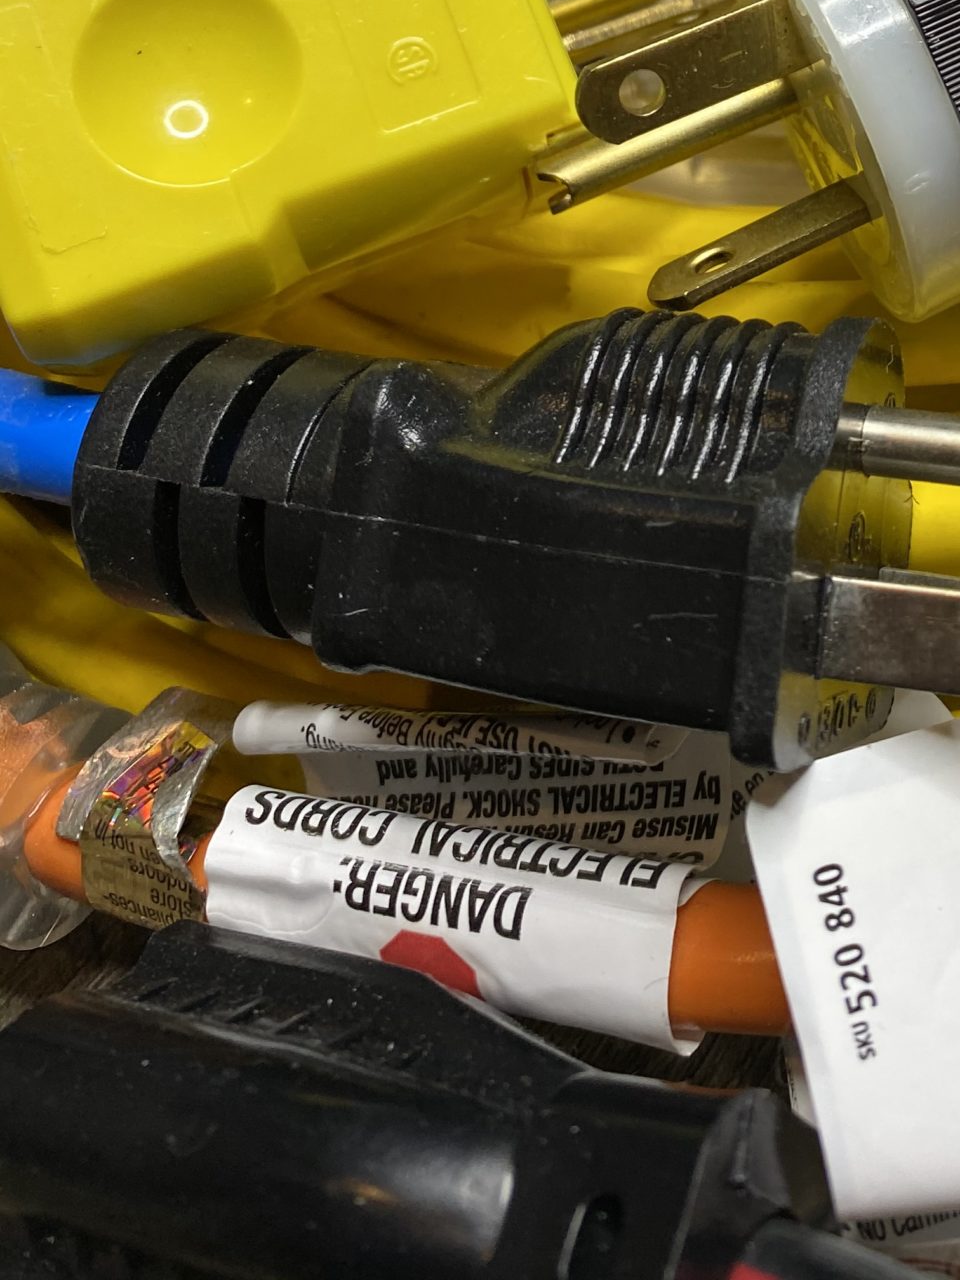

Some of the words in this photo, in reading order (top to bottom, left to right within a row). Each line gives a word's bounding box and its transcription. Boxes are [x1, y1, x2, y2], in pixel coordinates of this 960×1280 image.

[375, 758, 418, 786] and
[424, 752, 522, 783] Carefully
[462, 788, 541, 818] SHOCK.
[547, 779, 687, 816] ELECTRICAL
[692, 770, 721, 805] by
[246, 790, 399, 846] CORDS
[384, 790, 457, 820] Please
[110, 829, 136, 855] not
[581, 818, 627, 845] Can
[631, 813, 720, 842] Misuse
[411, 820, 670, 889] ELECTRICAL
[150, 887, 193, 918] store
[332, 856, 534, 940] DANGER:
[812, 863, 856, 932] 840
[834, 943, 878, 1015] 520
[851, 1020, 877, 1062] SKU
